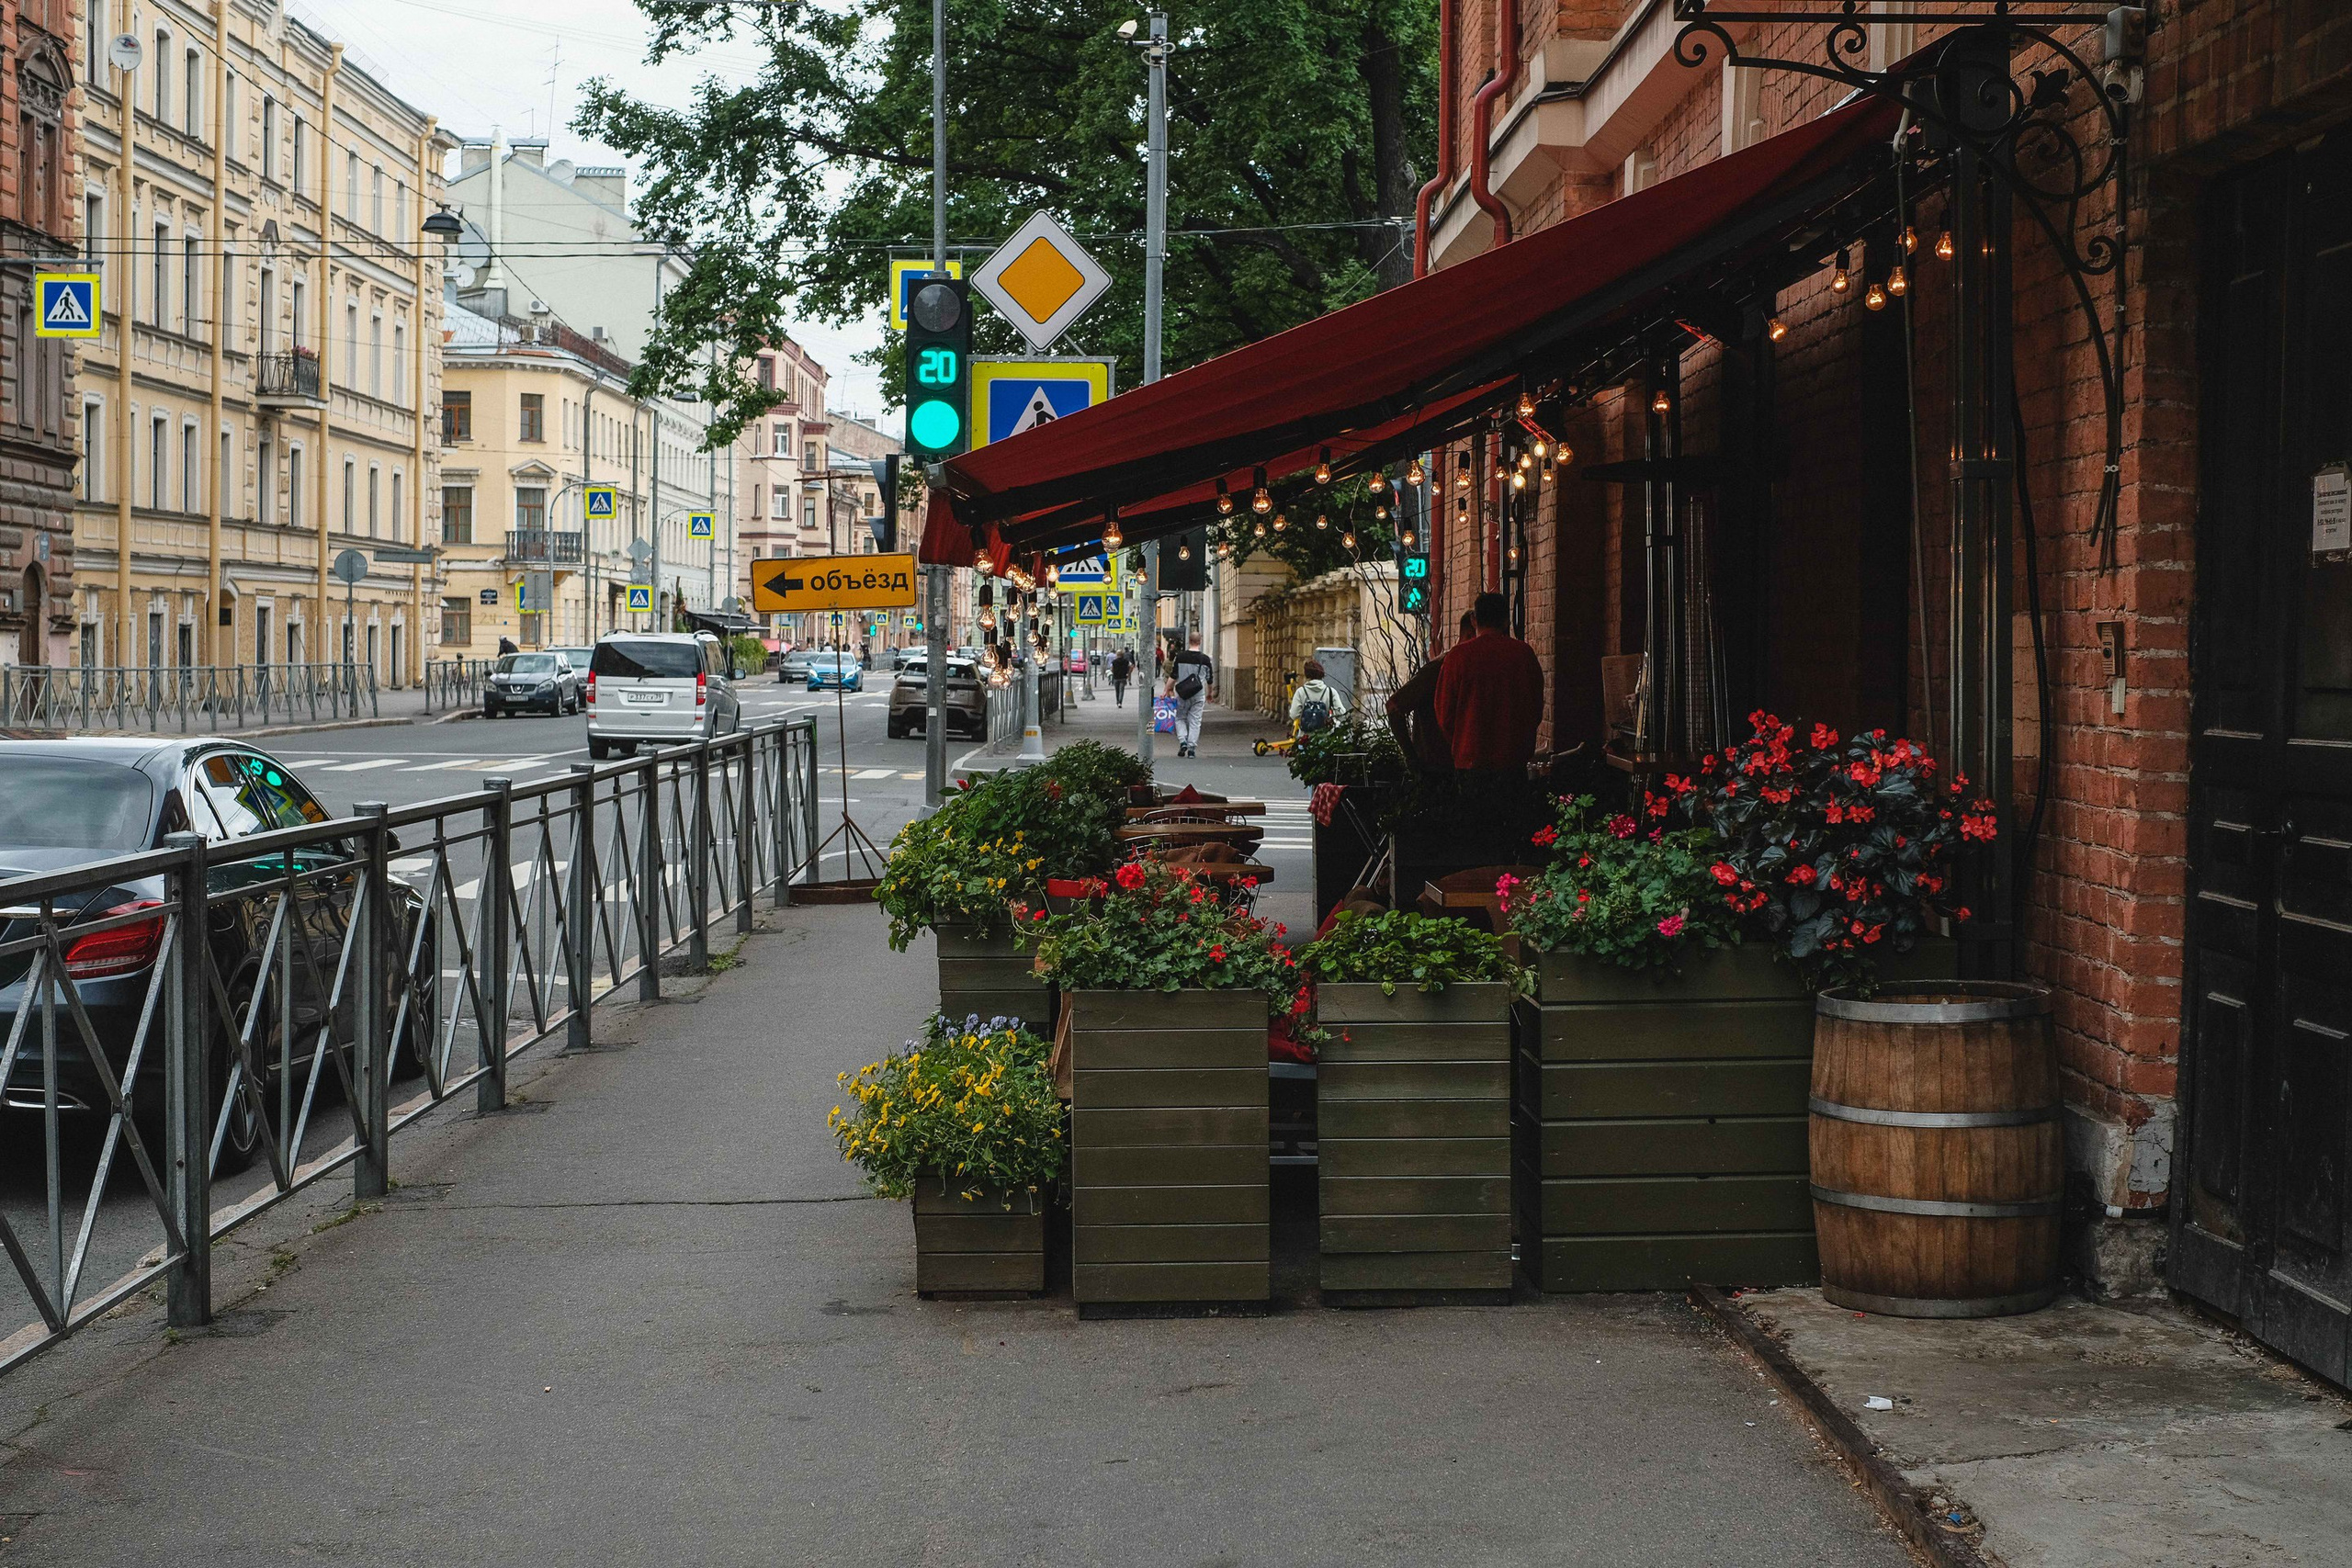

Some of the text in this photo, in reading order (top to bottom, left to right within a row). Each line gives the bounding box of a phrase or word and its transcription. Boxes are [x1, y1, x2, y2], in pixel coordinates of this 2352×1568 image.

[920, 350, 956, 383] 20
[1405, 558, 1426, 577] 20
[810, 569, 909, 592] объёзд
